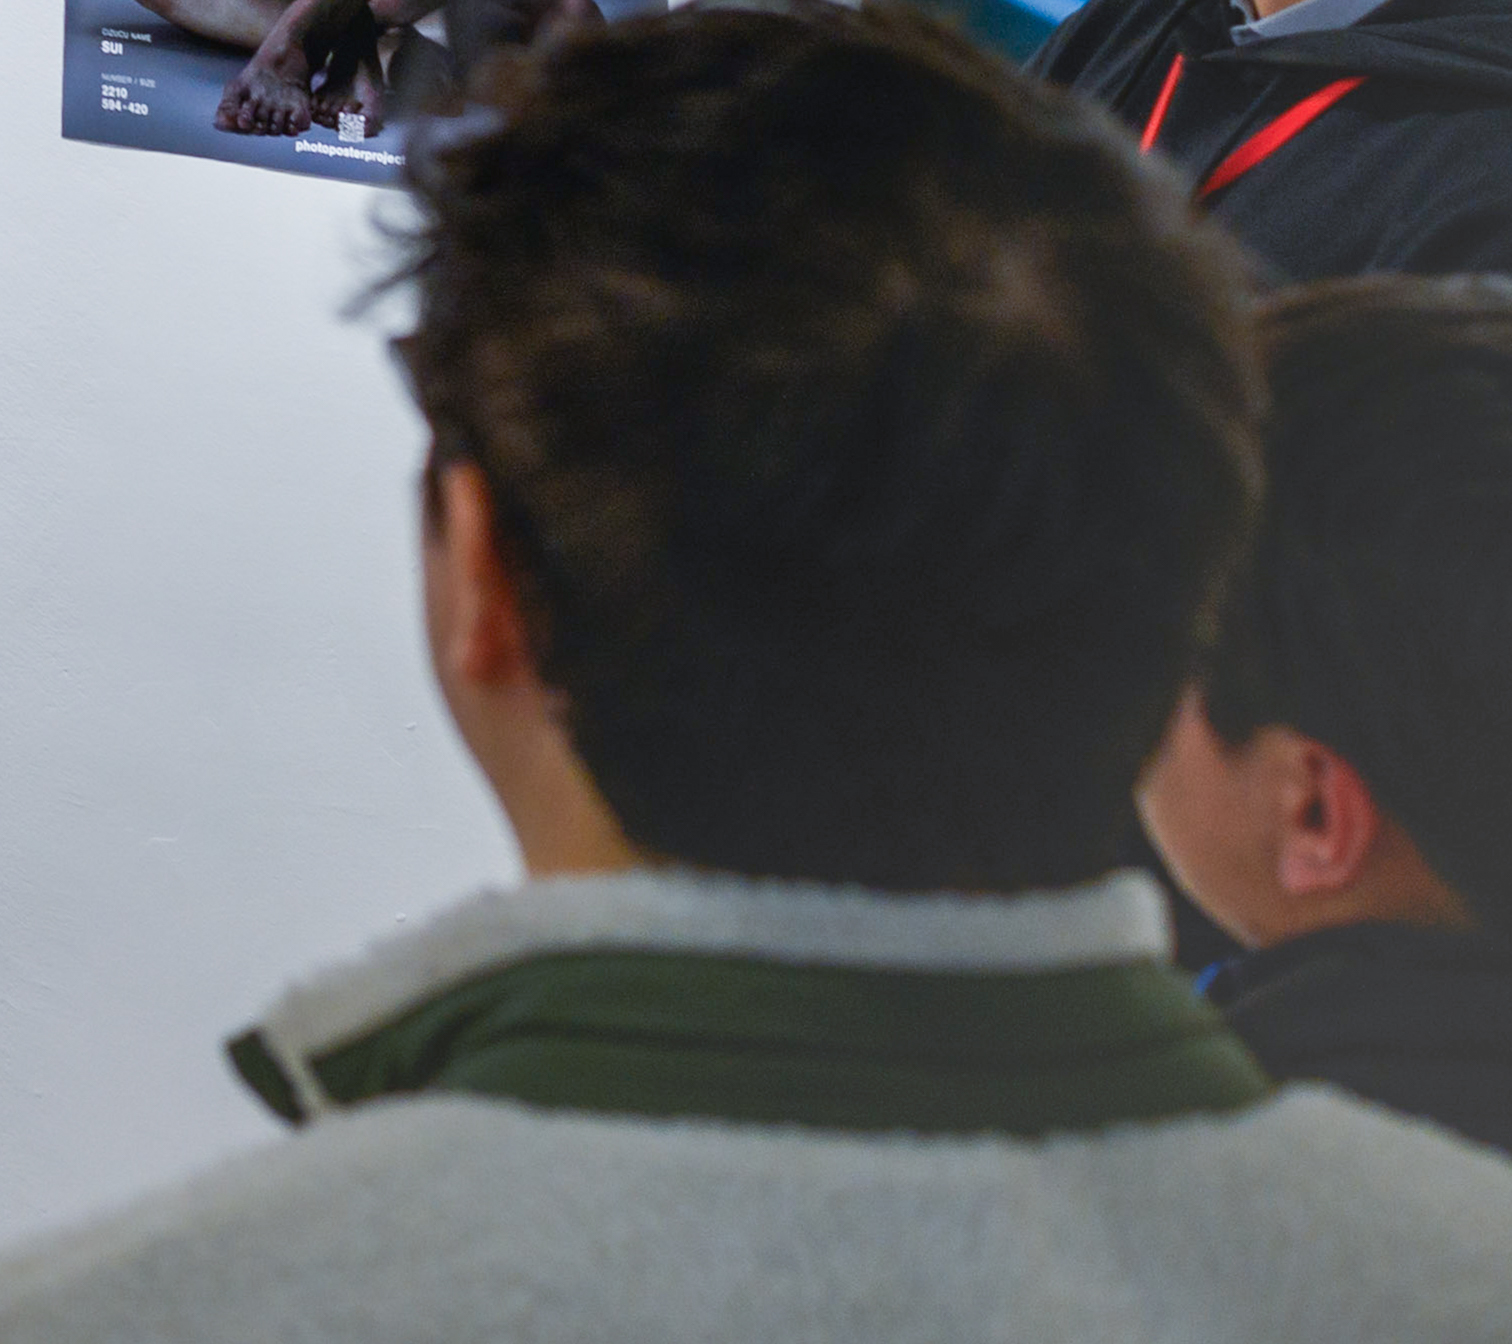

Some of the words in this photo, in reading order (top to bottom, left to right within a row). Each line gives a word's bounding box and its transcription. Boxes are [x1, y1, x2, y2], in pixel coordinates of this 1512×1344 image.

[130, 32, 152, 43] NAME
[100, 40, 123, 56] SUI
[101, 84, 128, 99] 2210
